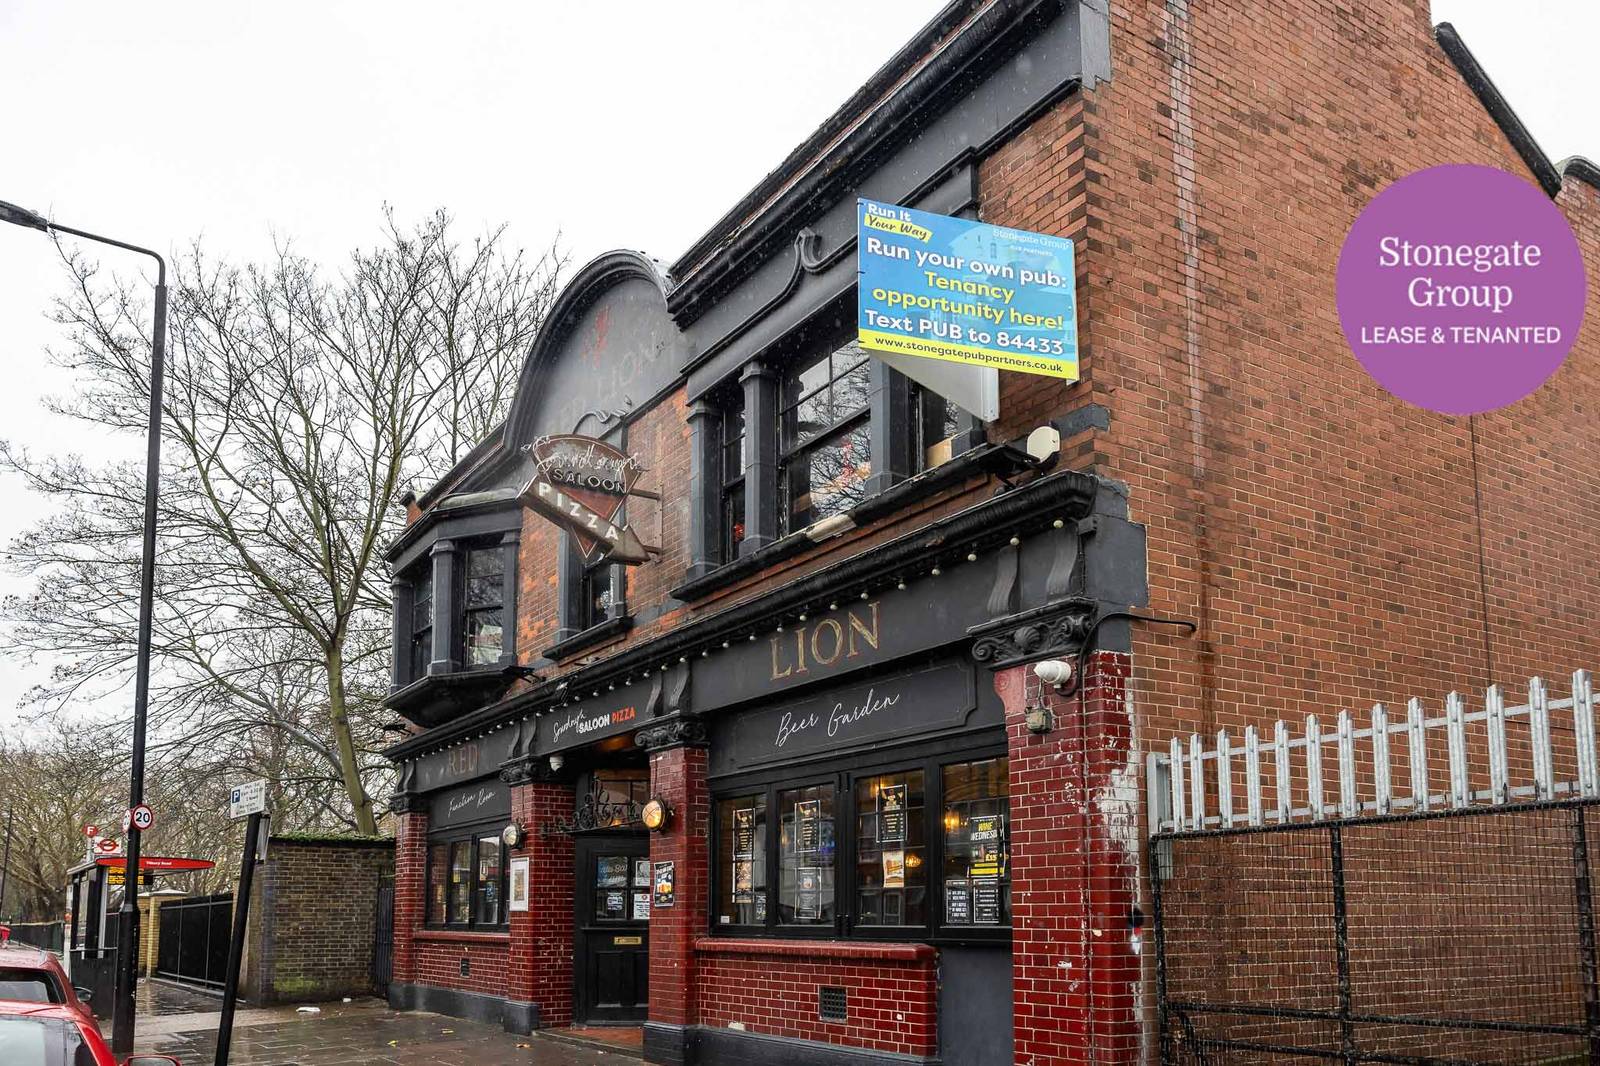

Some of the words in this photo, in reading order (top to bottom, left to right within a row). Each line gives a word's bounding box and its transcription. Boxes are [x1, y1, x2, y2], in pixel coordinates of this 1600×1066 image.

[867, 204, 896, 218] Run
[898, 210, 912, 222] It
[867, 215, 898, 232] Your
[900, 222, 929, 240] Way
[867, 238, 910, 261] Run
[915, 250, 965, 270] your
[969, 260, 1014, 279] own
[1020, 270, 1068, 288] pub:
[924, 271, 1016, 304] Tenancy
[872, 288, 1005, 324] opportunity
[1010, 307, 1064, 330] here!
[865, 309, 913, 332] Text
[920, 318, 962, 340] PUB
[968, 326, 991, 345] to
[996, 332, 1064, 356] 84433
[875, 337, 1063, 373] www.stonegatepubpartners.co.uk
[553, 468, 627, 494] SALOON
[538, 481, 619, 541] PIZZA
[769, 600, 881, 681] LION
[578, 713, 610, 734] SALOON
[611, 706, 636, 724] PIZZA
[776, 711, 820, 747] Beer
[827, 688, 900, 738] Garden
[448, 744, 480, 777] RED
[136, 812, 150, 823] 20
